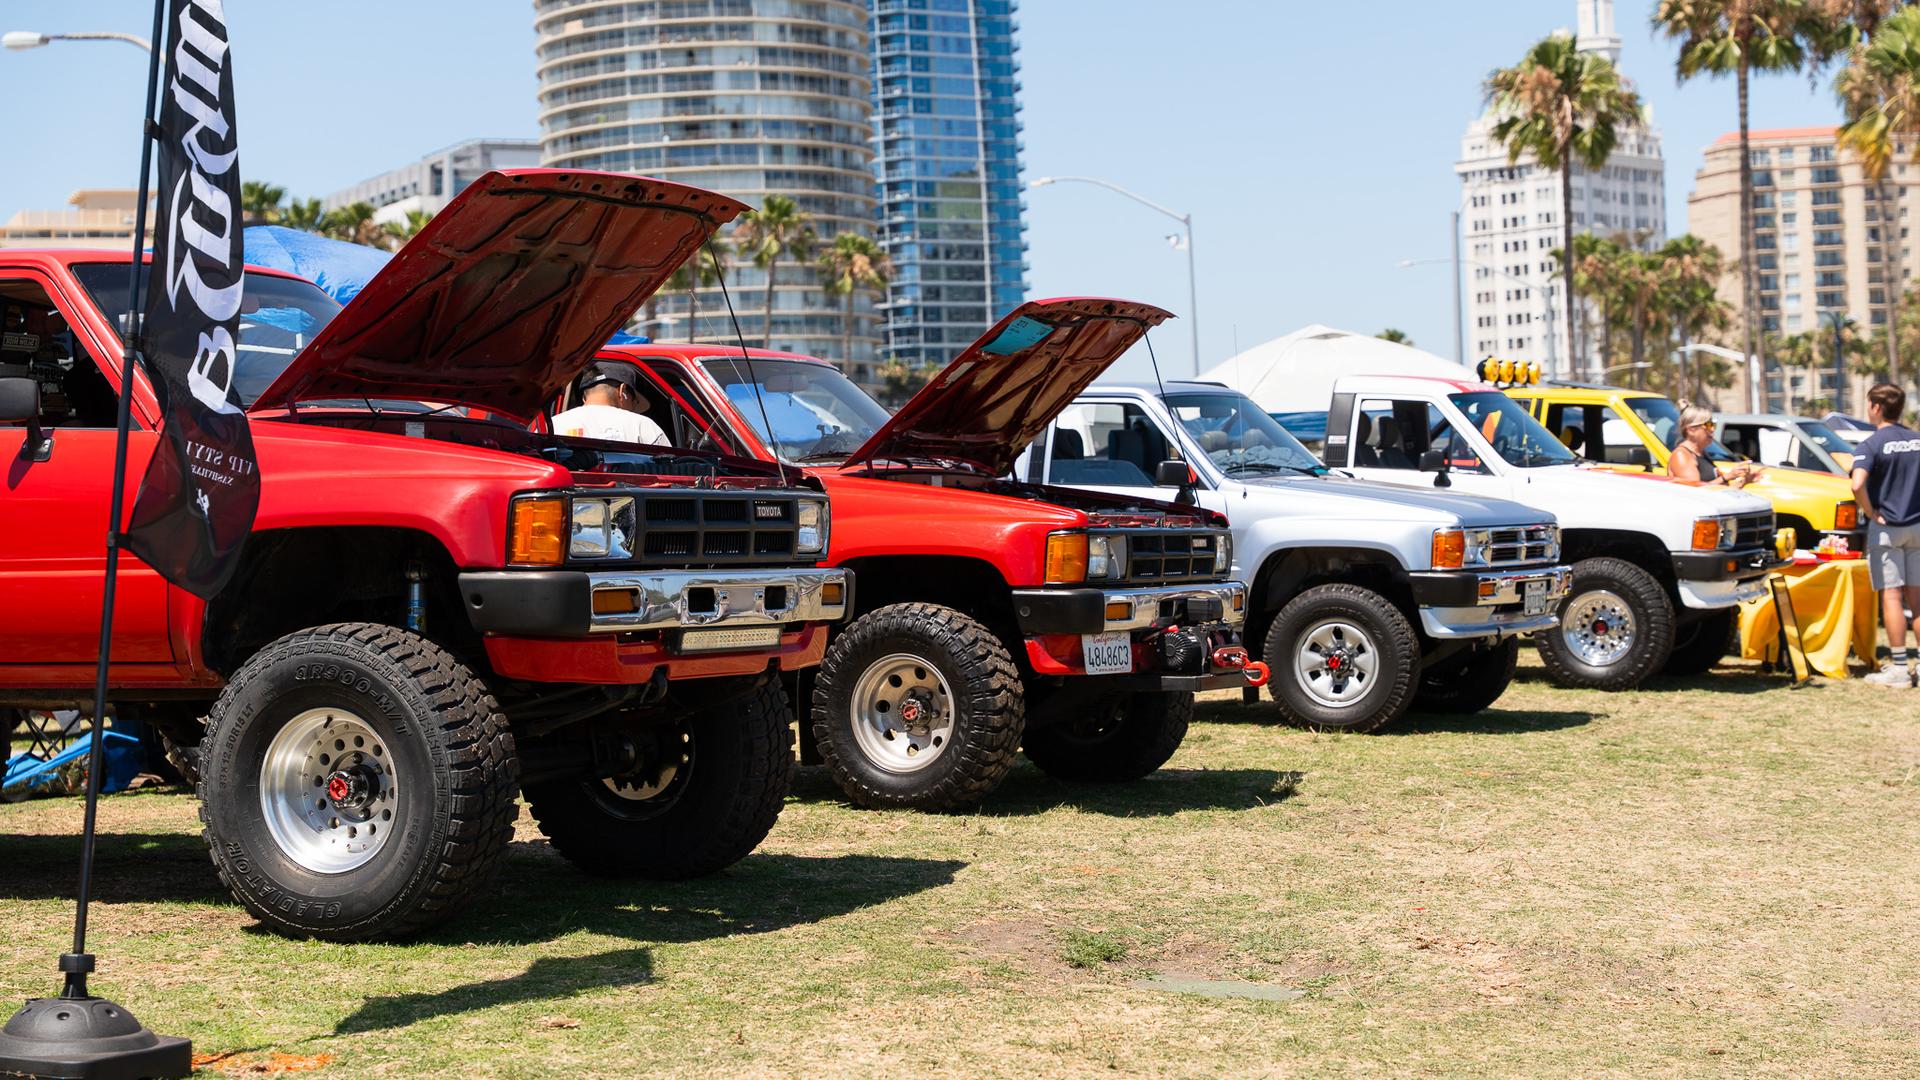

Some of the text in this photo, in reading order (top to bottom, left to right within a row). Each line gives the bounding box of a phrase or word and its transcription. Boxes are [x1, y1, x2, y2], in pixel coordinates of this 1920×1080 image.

[756, 506, 782, 517] TOYOTA
[1088, 645, 1129, 667] 48486C3
[226, 841, 342, 919] GLADIATOR
